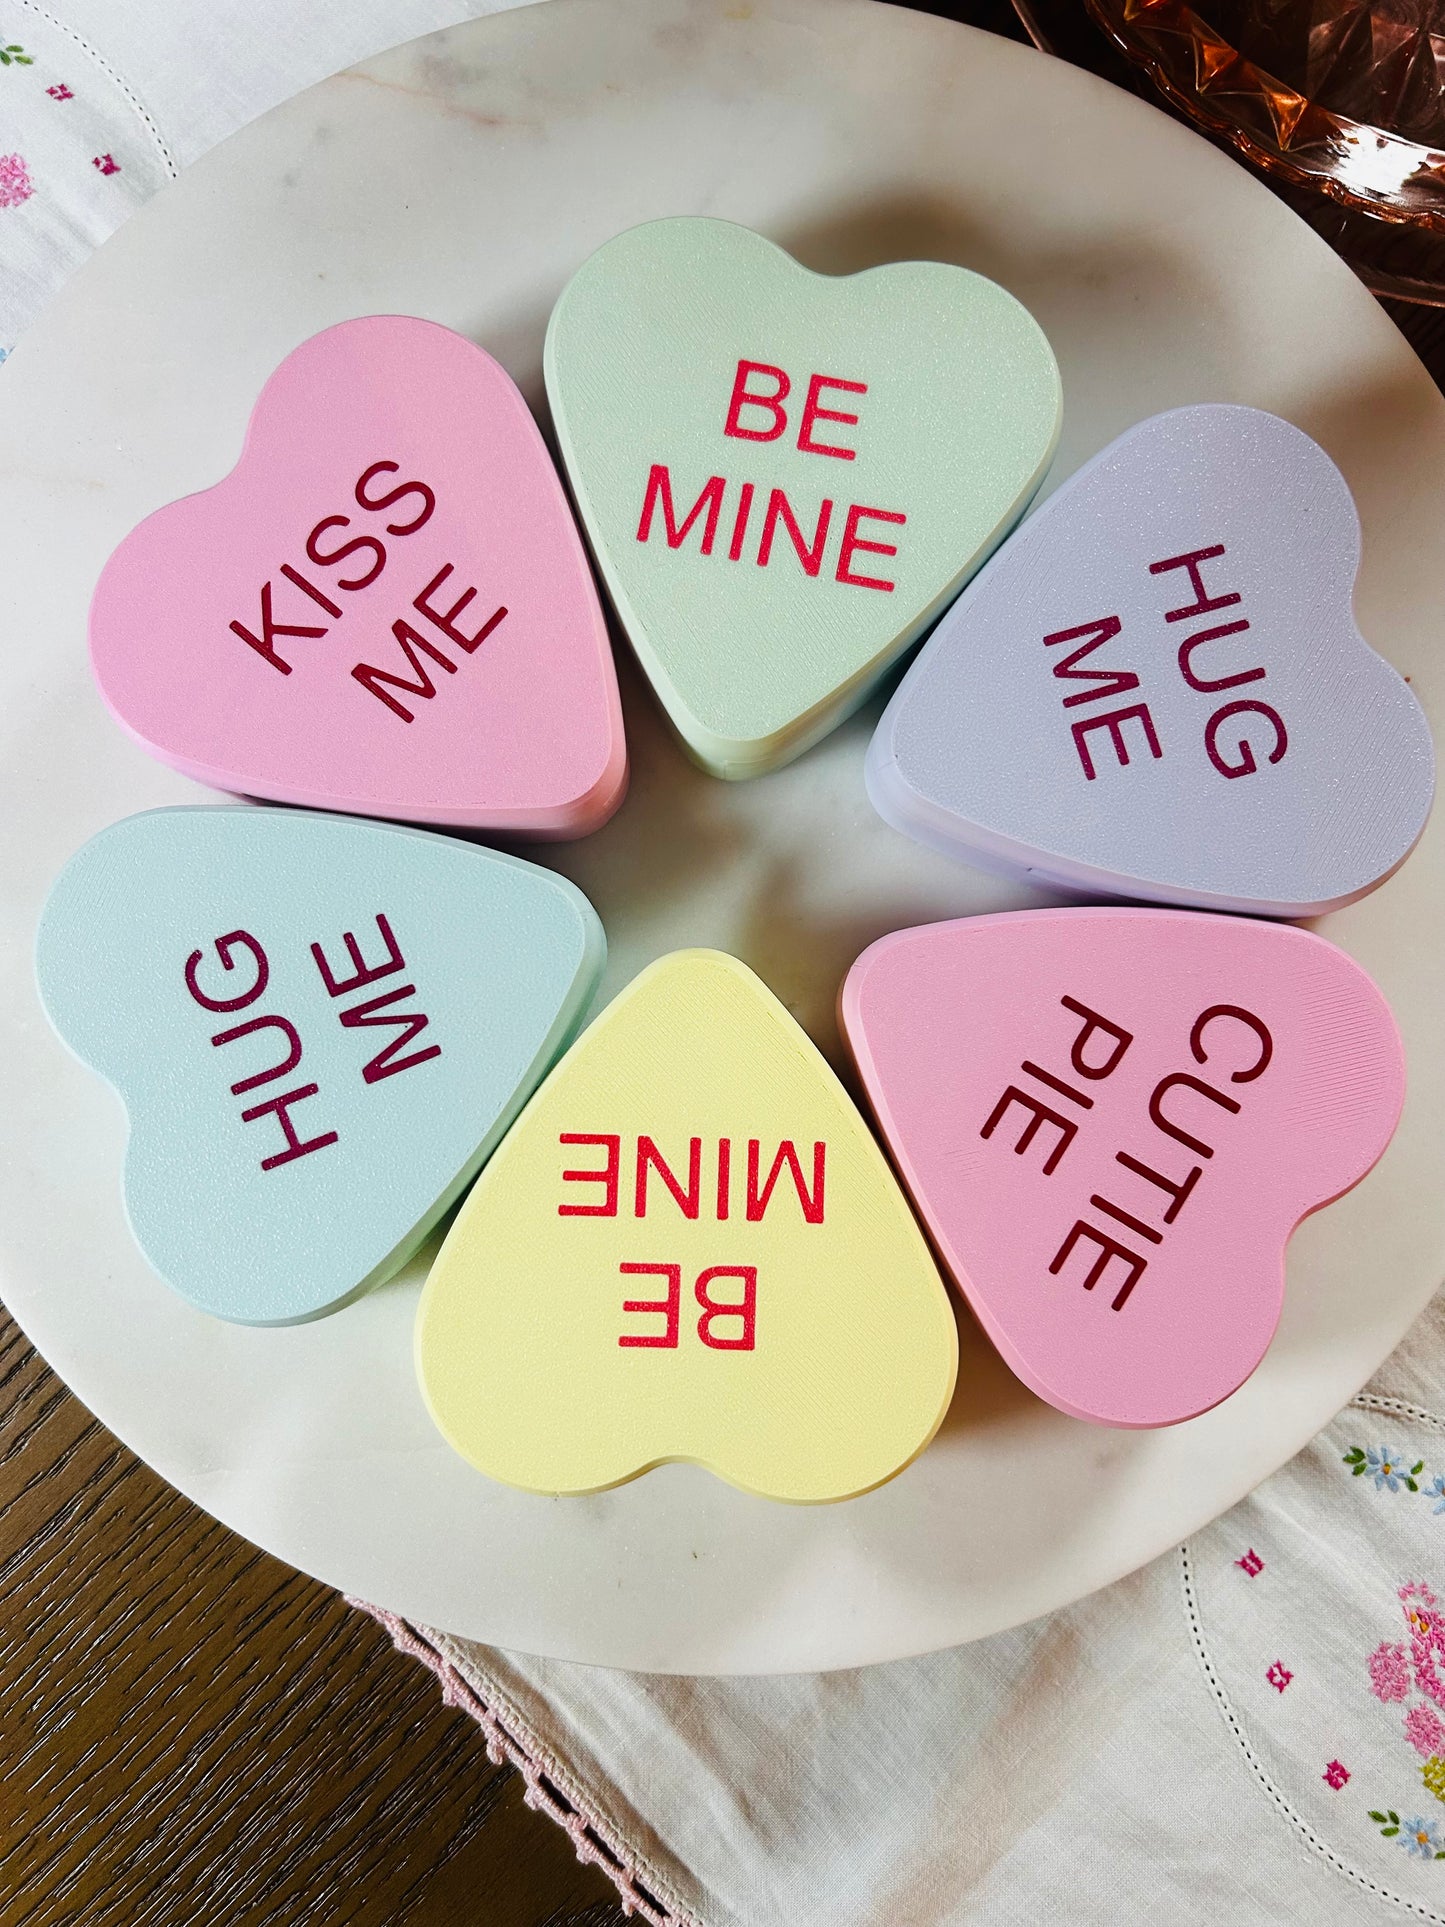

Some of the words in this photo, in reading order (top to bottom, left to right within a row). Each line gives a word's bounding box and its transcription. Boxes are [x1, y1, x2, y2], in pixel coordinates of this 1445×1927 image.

[724, 359, 868, 461] BE
[229, 460, 436, 677] KISS
[635, 463, 907, 593] MINE
[350, 562, 508, 724] ME
[1043, 615, 1163, 781] ME
[1149, 544, 1289, 780] HUG
[185, 930, 339, 1171] HUG
[311, 913, 441, 1085] ME
[979, 994, 1135, 1177] PIE
[1047, 1003, 1274, 1313] CUTIE
[557, 1132, 826, 1225] MINE
[618, 1262, 758, 1352] BE
